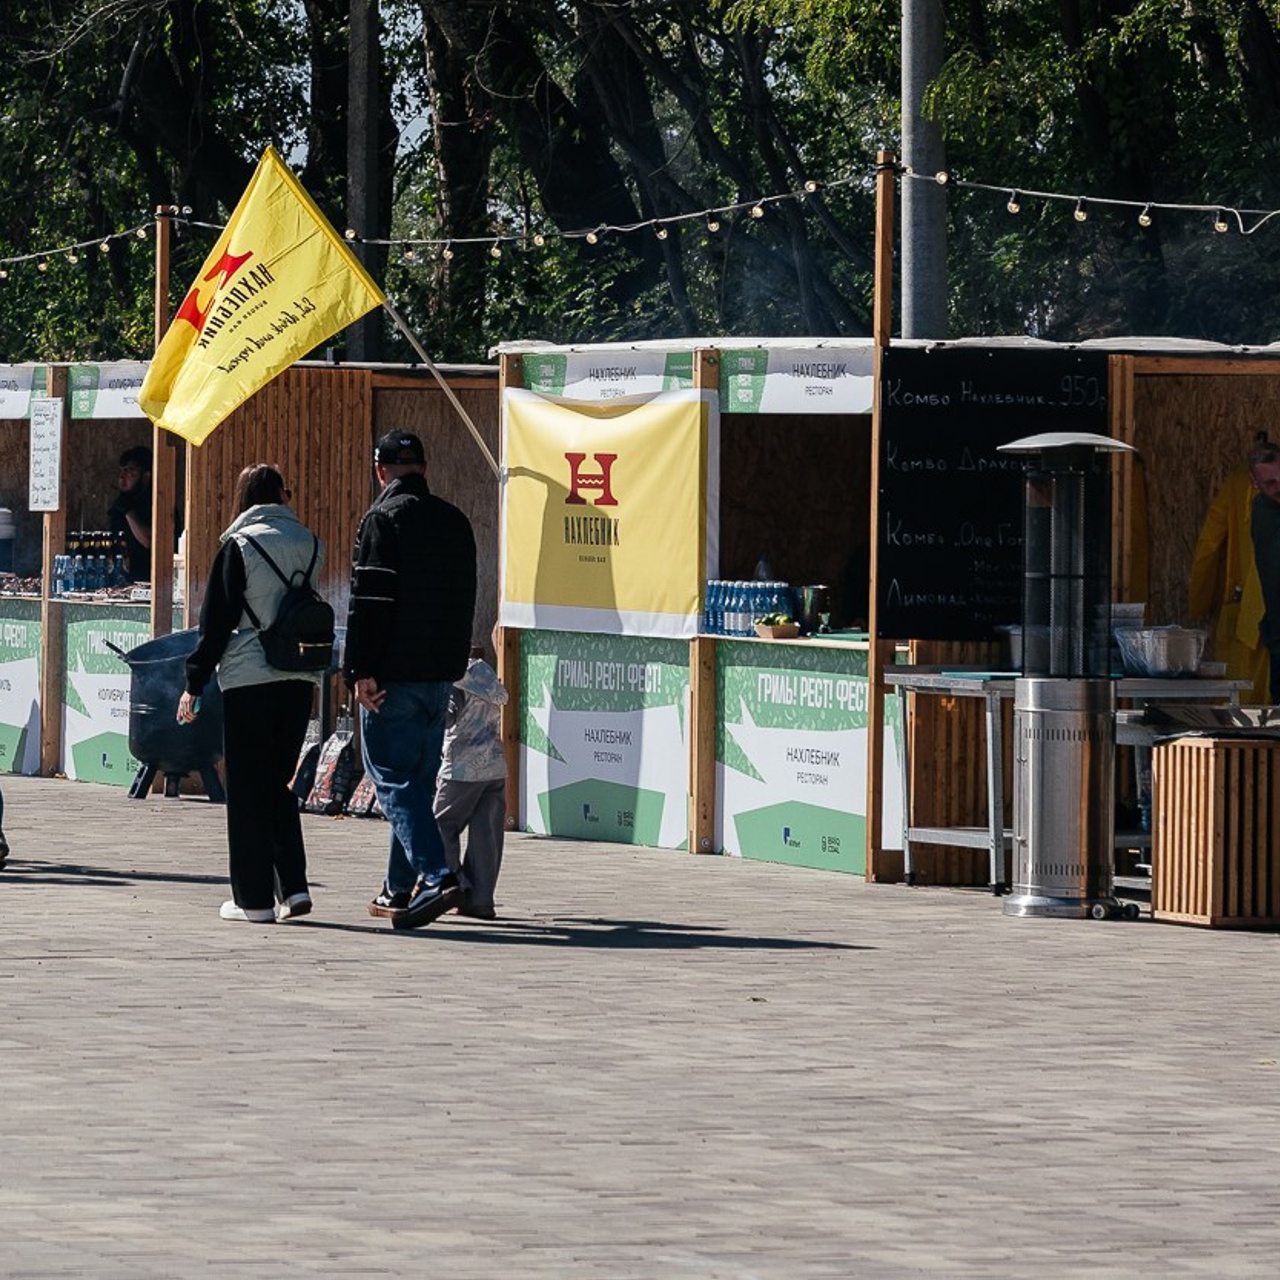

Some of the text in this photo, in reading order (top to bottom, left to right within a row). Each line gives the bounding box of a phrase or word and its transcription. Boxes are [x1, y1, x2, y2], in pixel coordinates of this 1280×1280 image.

[589, 366, 637, 382] НАХЛЕБНИК
[792, 363, 847, 380] НАХЛЕБНИК
[564, 516, 619, 546] НАХЛЕБНИК
[558, 660, 661, 693] ГРИЛЬ! РЕСТ! ФЕСТ!
[758, 673, 869, 712] ГРИЛЬ! РЕСТ! ФЕСТ
[584, 728, 632, 745] НАХЛЕБНИК
[593, 751, 622, 764] РЕСТОРАН
[786, 747, 840, 766] НАХЛЕБНИК
[797, 771, 828, 785] РЕСТОРАН
